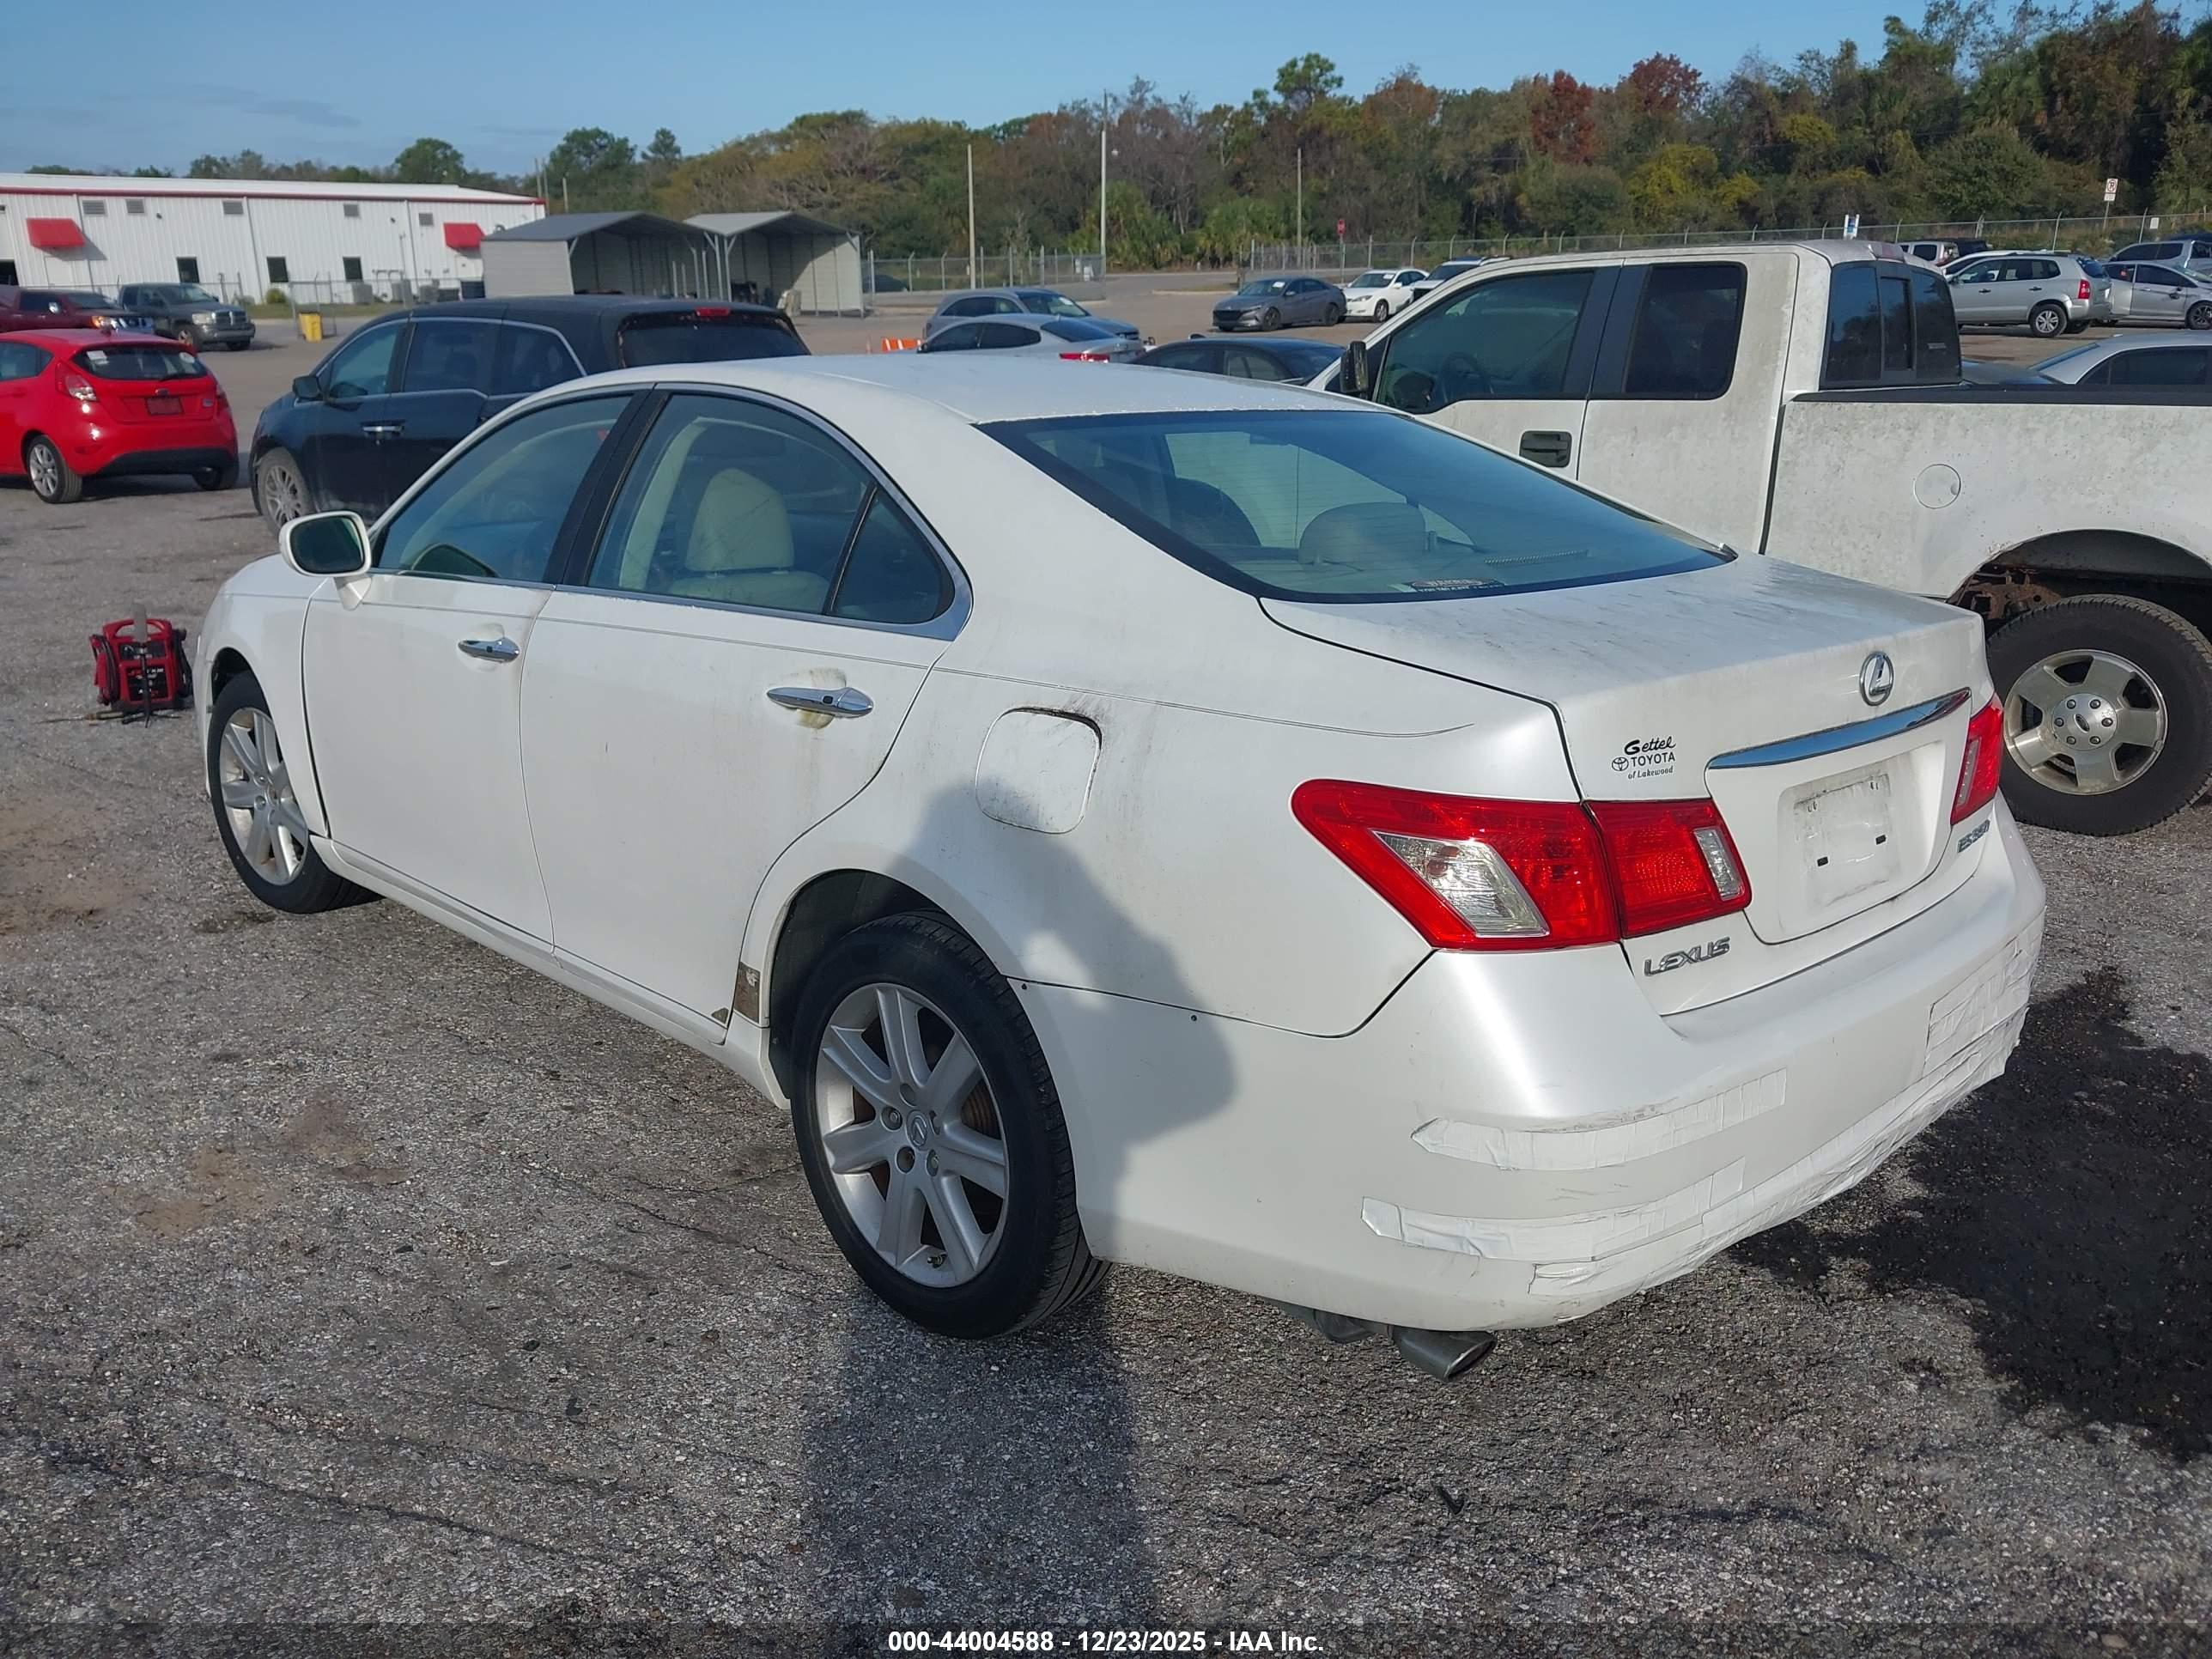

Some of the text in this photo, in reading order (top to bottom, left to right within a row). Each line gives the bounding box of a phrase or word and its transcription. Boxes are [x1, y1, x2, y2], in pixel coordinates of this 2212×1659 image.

[1624, 736, 1676, 755] Gettel
[1631, 752, 1675, 767] TOYOTA
[1628, 766, 1674, 780] of Lakewood
[1644, 936, 1730, 976] LEXUS
